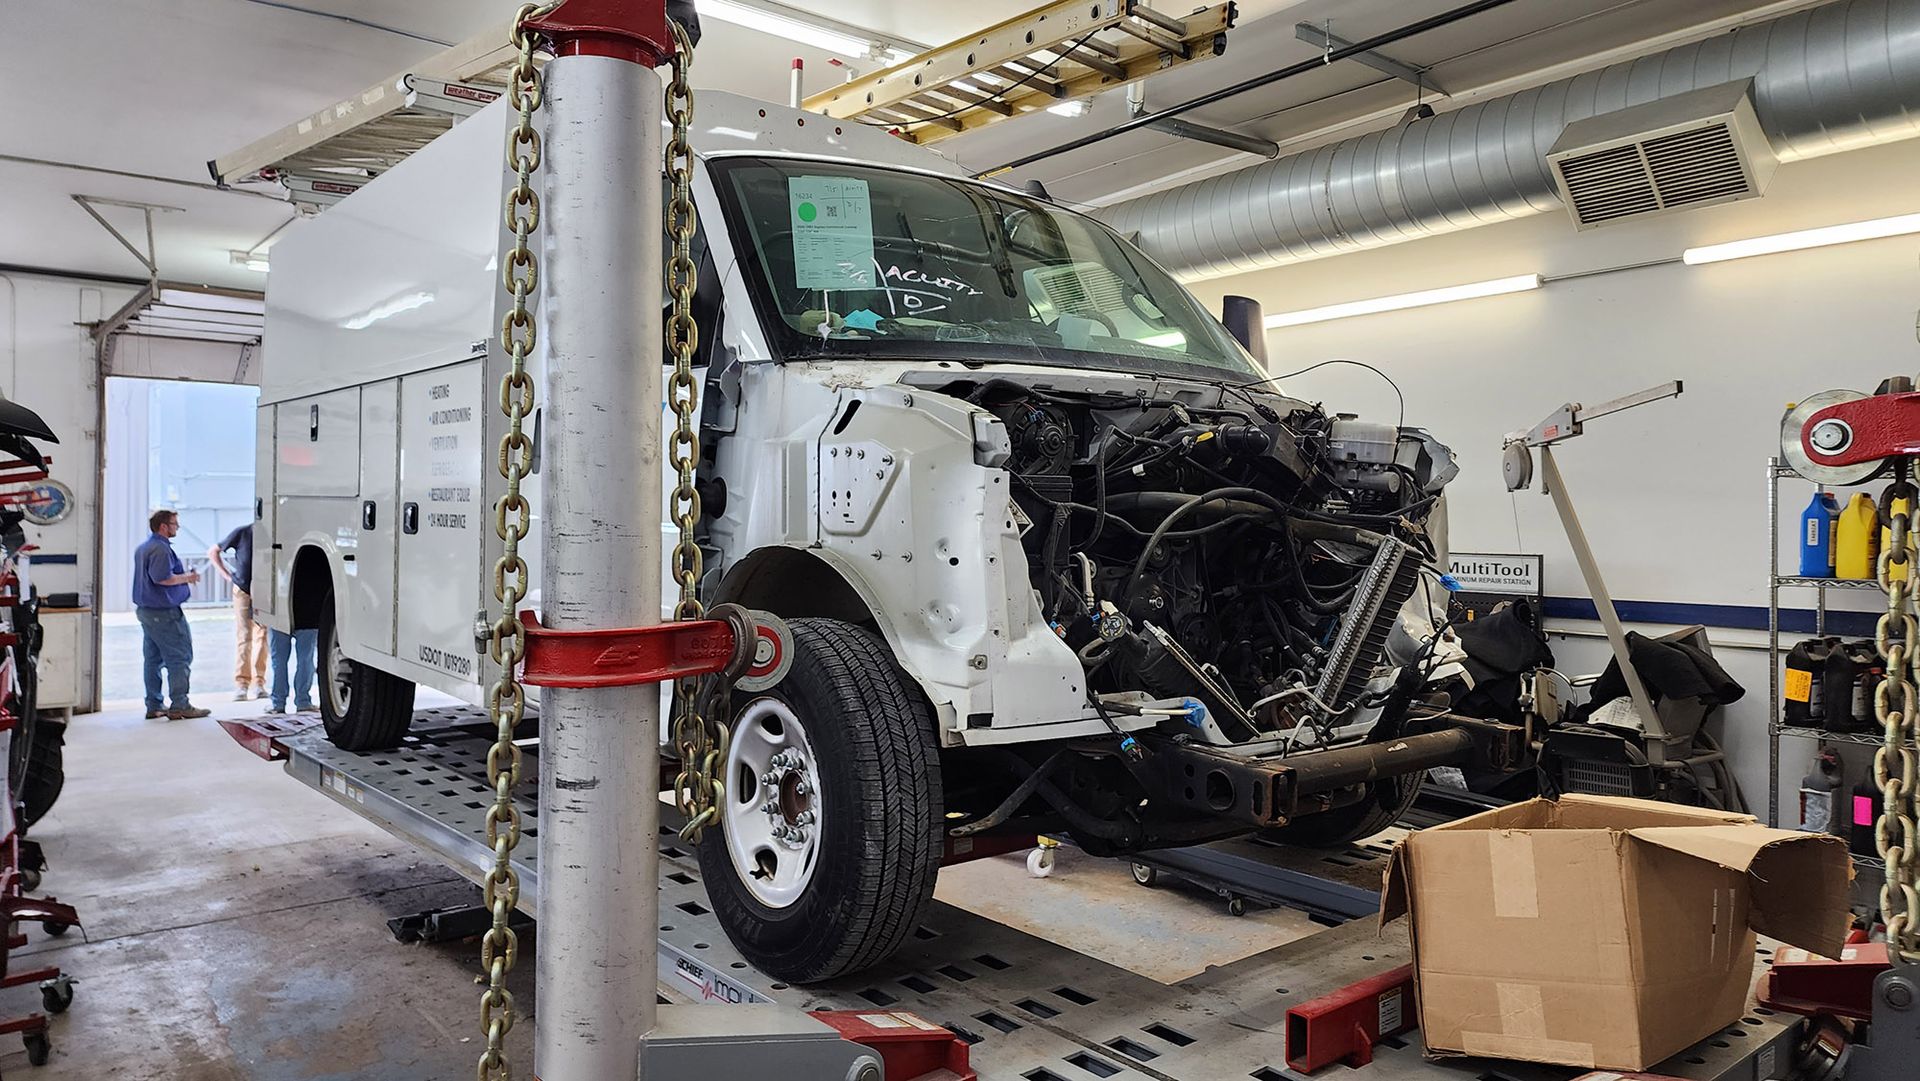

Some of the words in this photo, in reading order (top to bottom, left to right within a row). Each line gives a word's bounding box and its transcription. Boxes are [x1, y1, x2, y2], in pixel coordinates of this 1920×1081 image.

[432, 384, 449, 400] HEATING
[440, 407, 471, 424] CONDITIONING
[1448, 562, 1529, 576] MultiTool
[1453, 576, 1477, 584] MINUM
[1479, 577, 1502, 585] REPAIR
[1503, 578, 1532, 586] STATION
[419, 644, 441, 667] USDOT
